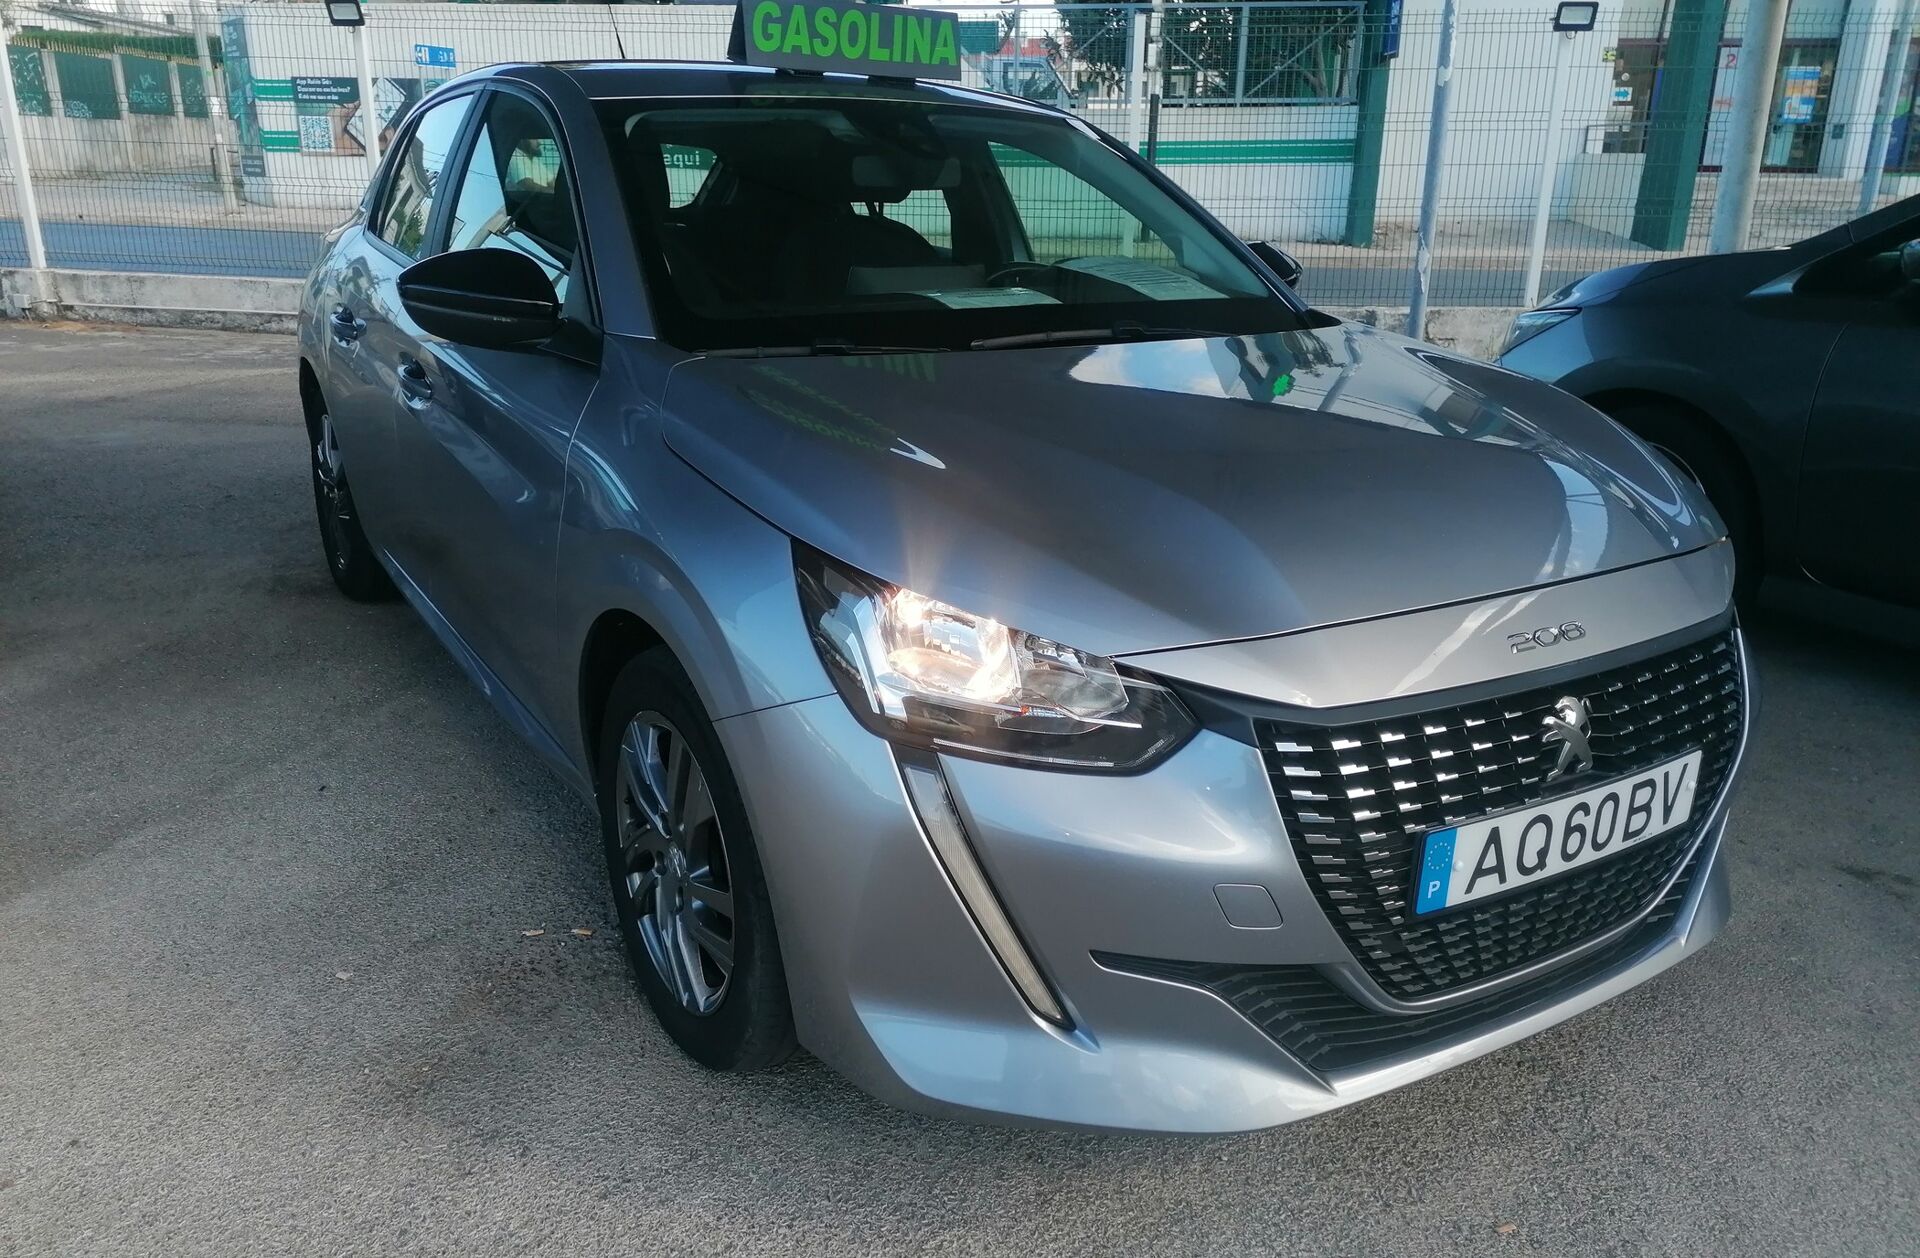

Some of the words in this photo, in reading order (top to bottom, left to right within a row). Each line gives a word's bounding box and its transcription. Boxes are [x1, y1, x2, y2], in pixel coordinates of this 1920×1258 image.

[752, 1, 960, 66] GASOLINA
[1507, 621, 1586, 654] 208
[1464, 762, 1689, 895] AQ60BV
[1427, 880, 1441, 899] P
